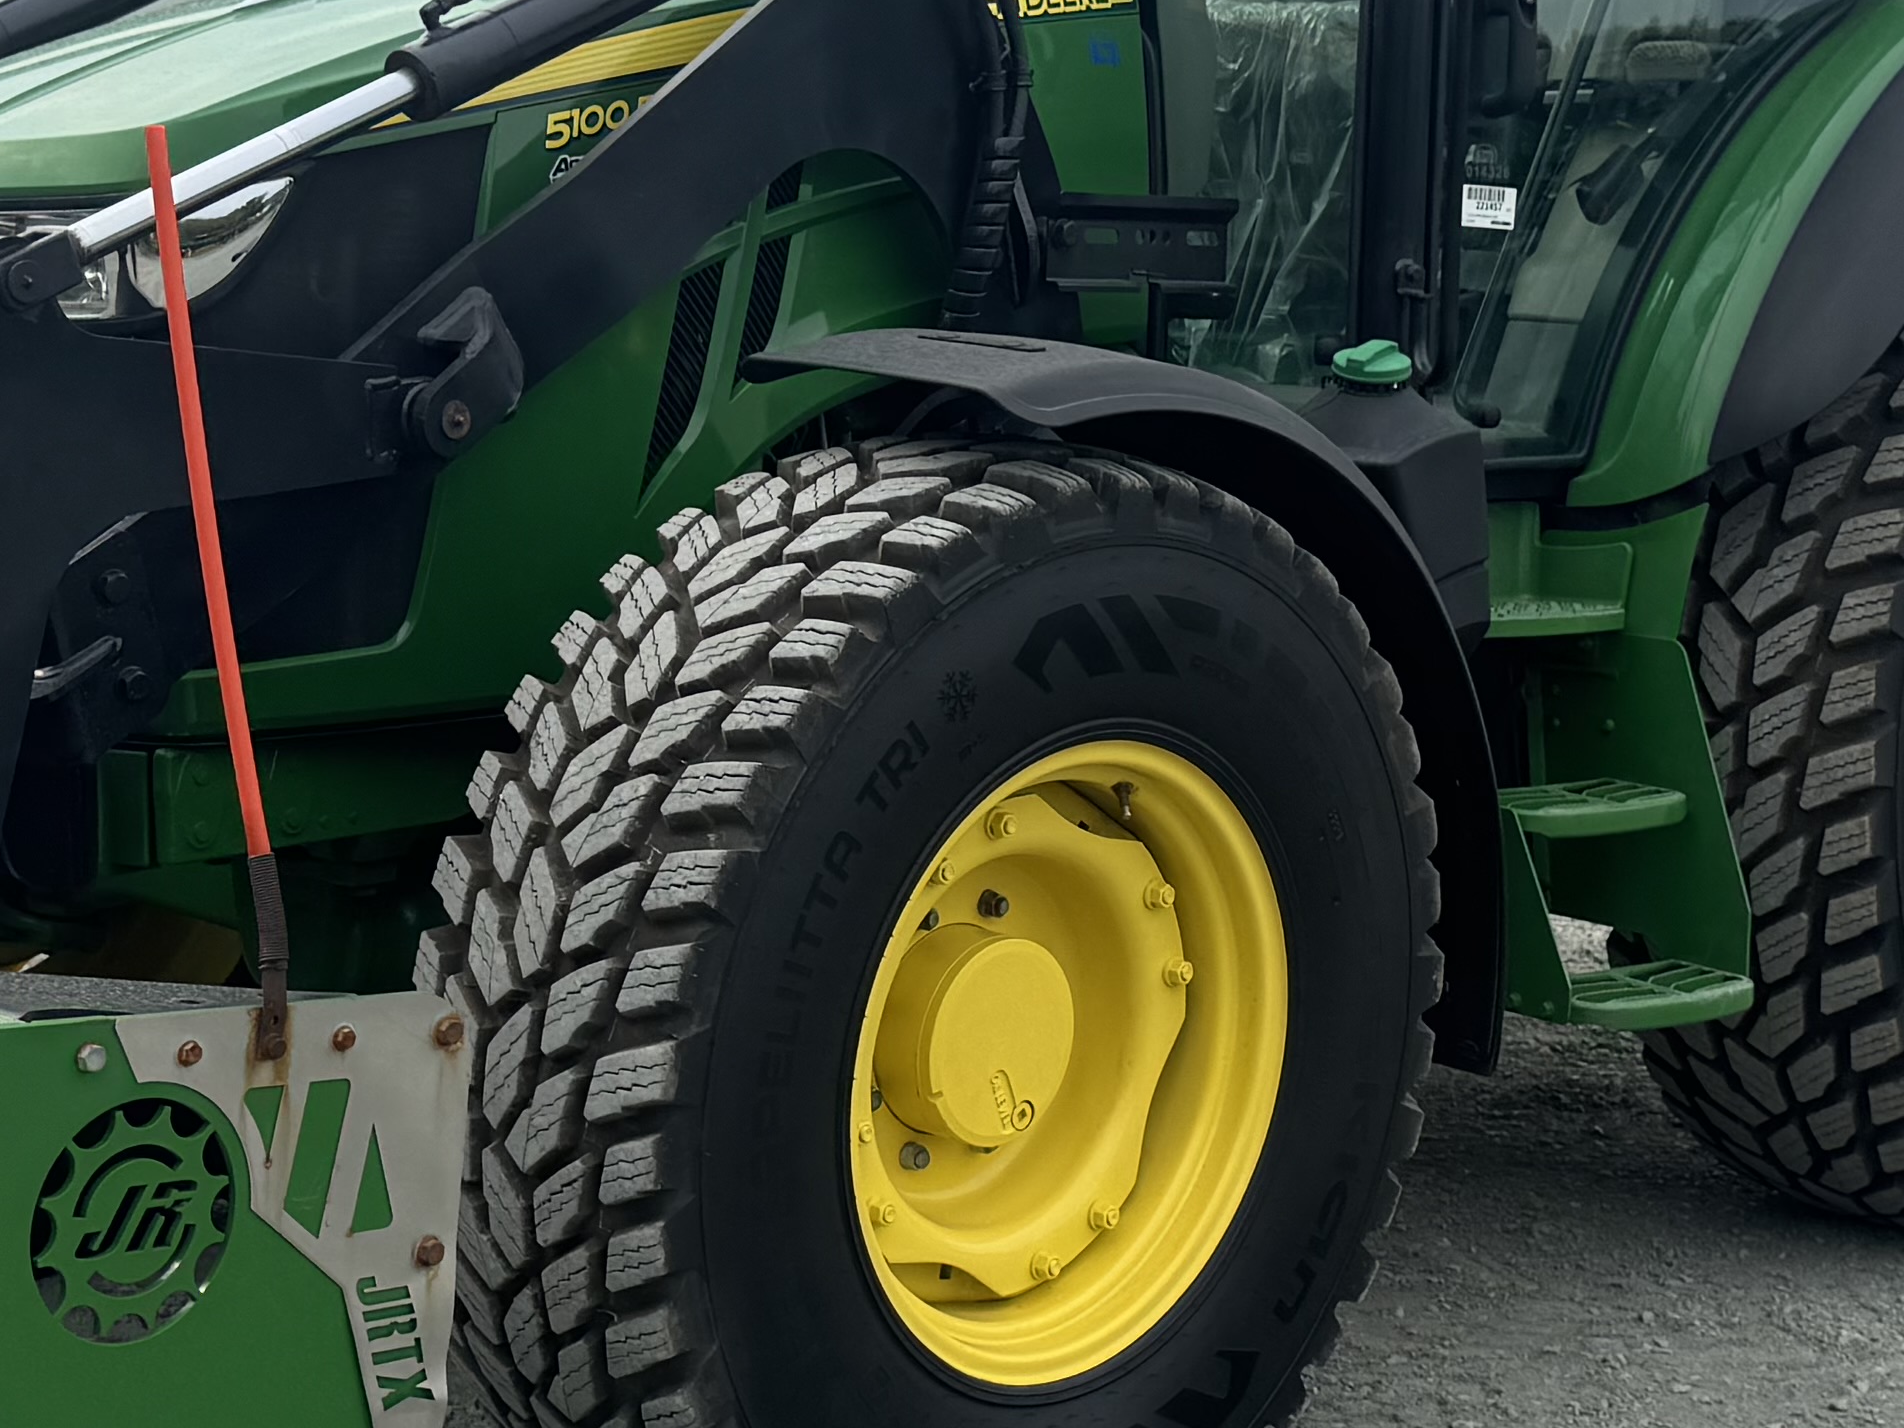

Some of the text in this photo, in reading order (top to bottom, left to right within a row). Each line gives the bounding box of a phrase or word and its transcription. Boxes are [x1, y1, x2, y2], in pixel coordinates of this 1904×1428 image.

[855, 720, 929, 814] TRI
[75, 1179, 198, 1259] JR
[355, 1274, 436, 1412] JRTX
